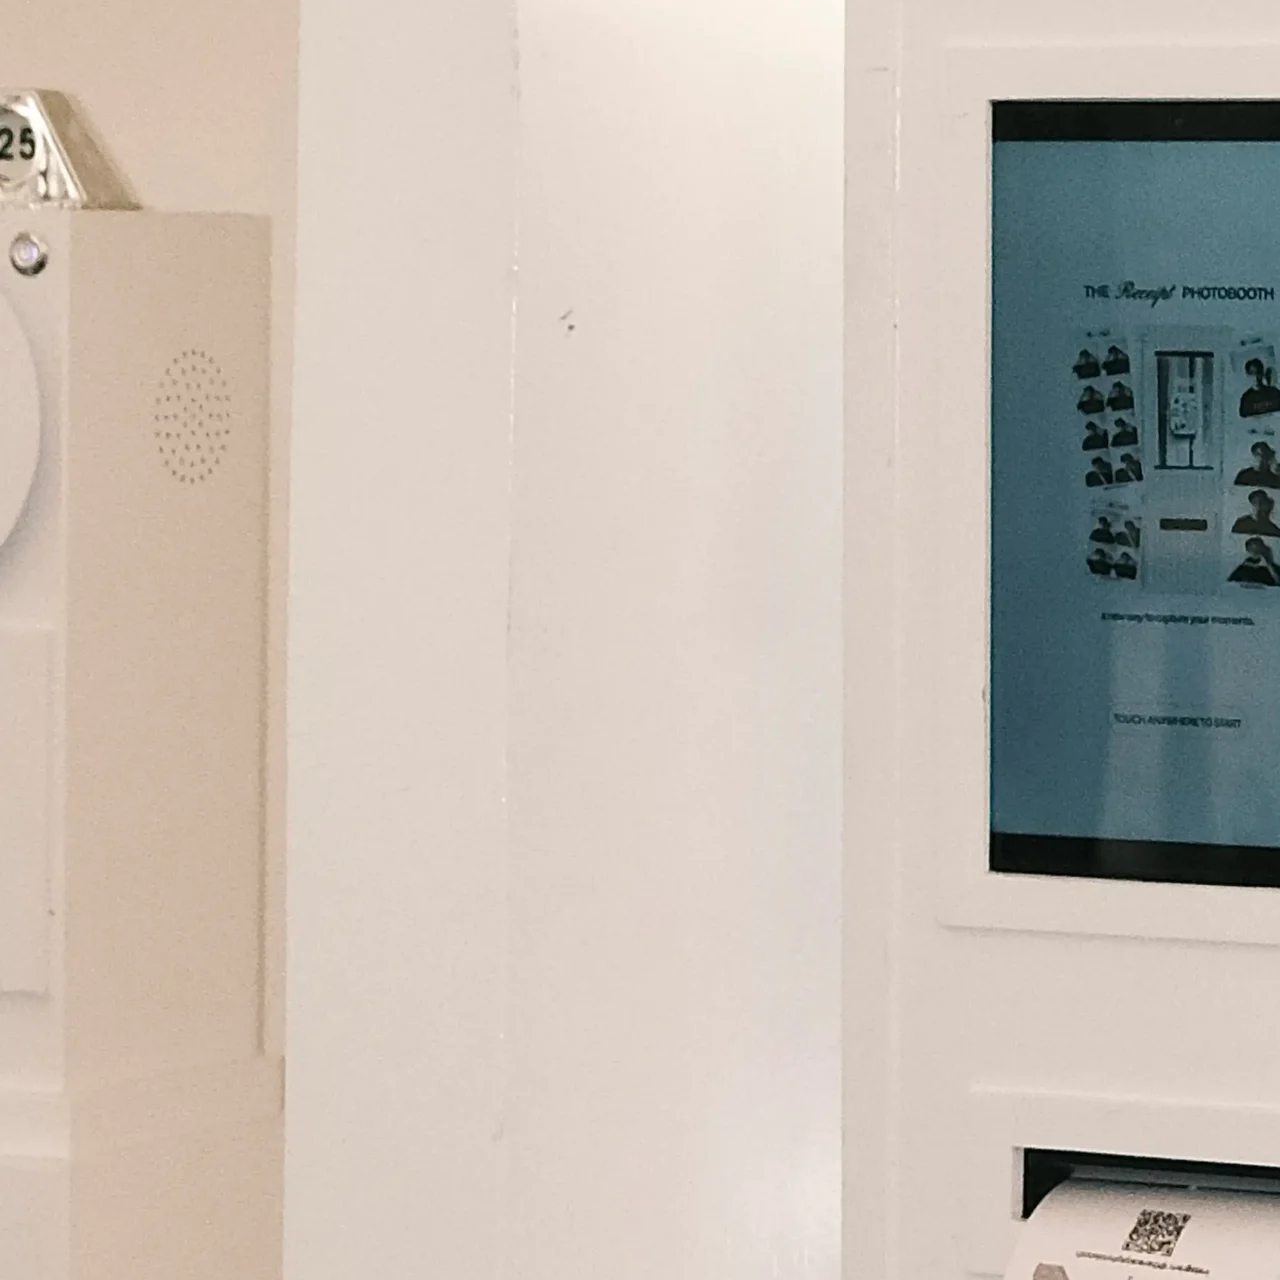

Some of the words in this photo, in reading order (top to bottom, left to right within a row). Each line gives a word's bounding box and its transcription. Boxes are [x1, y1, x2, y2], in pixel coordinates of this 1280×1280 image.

[1083, 284, 1110, 299] THE
[1115, 280, 1176, 308] Receipt
[1182, 285, 1275, 301] PHOTOBOOTH
